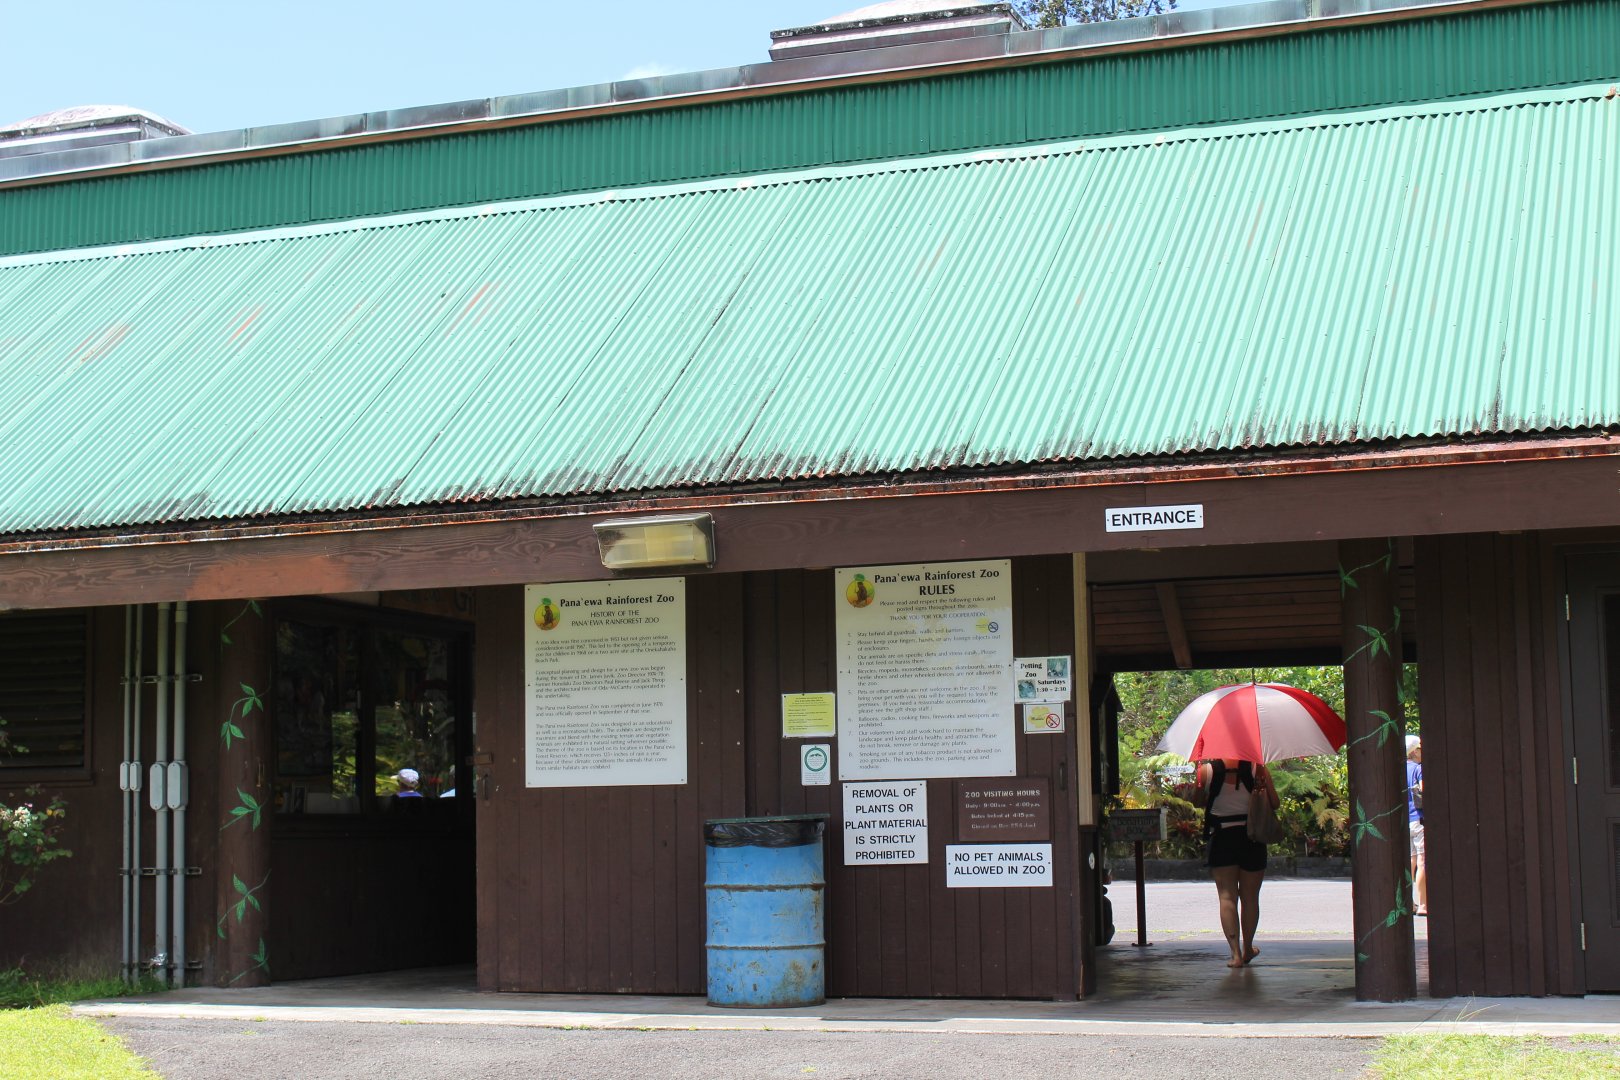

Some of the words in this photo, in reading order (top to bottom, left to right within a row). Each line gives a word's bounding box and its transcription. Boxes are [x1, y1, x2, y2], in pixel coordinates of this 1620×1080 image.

[1112, 510, 1196, 526] ENTRANCE
[925, 571, 976, 580] Rainforest
[980, 569, 999, 577] Zoo
[920, 585, 954, 595] RULES
[606, 595, 652, 604] Rainforest
[852, 789, 899, 798] REMOVAL
[904, 788, 917, 796] OF
[856, 804, 894, 813] PLANTS
[899, 804, 913, 812] OR
[845, 821, 877, 829] PLANT
[879, 819, 927, 828] MATERIAL
[856, 836, 865, 844] IS
[870, 835, 915, 844] STRICTLY
[856, 850, 915, 859] PROHIBITED
[955, 853, 970, 861] NO
[974, 853, 993, 861] PET
[998, 853, 1043, 861] ANIMALS
[954, 866, 1003, 874] ALLOWED
[1008, 866, 1018, 874] IN
[1023, 866, 1045, 874] ZOO
